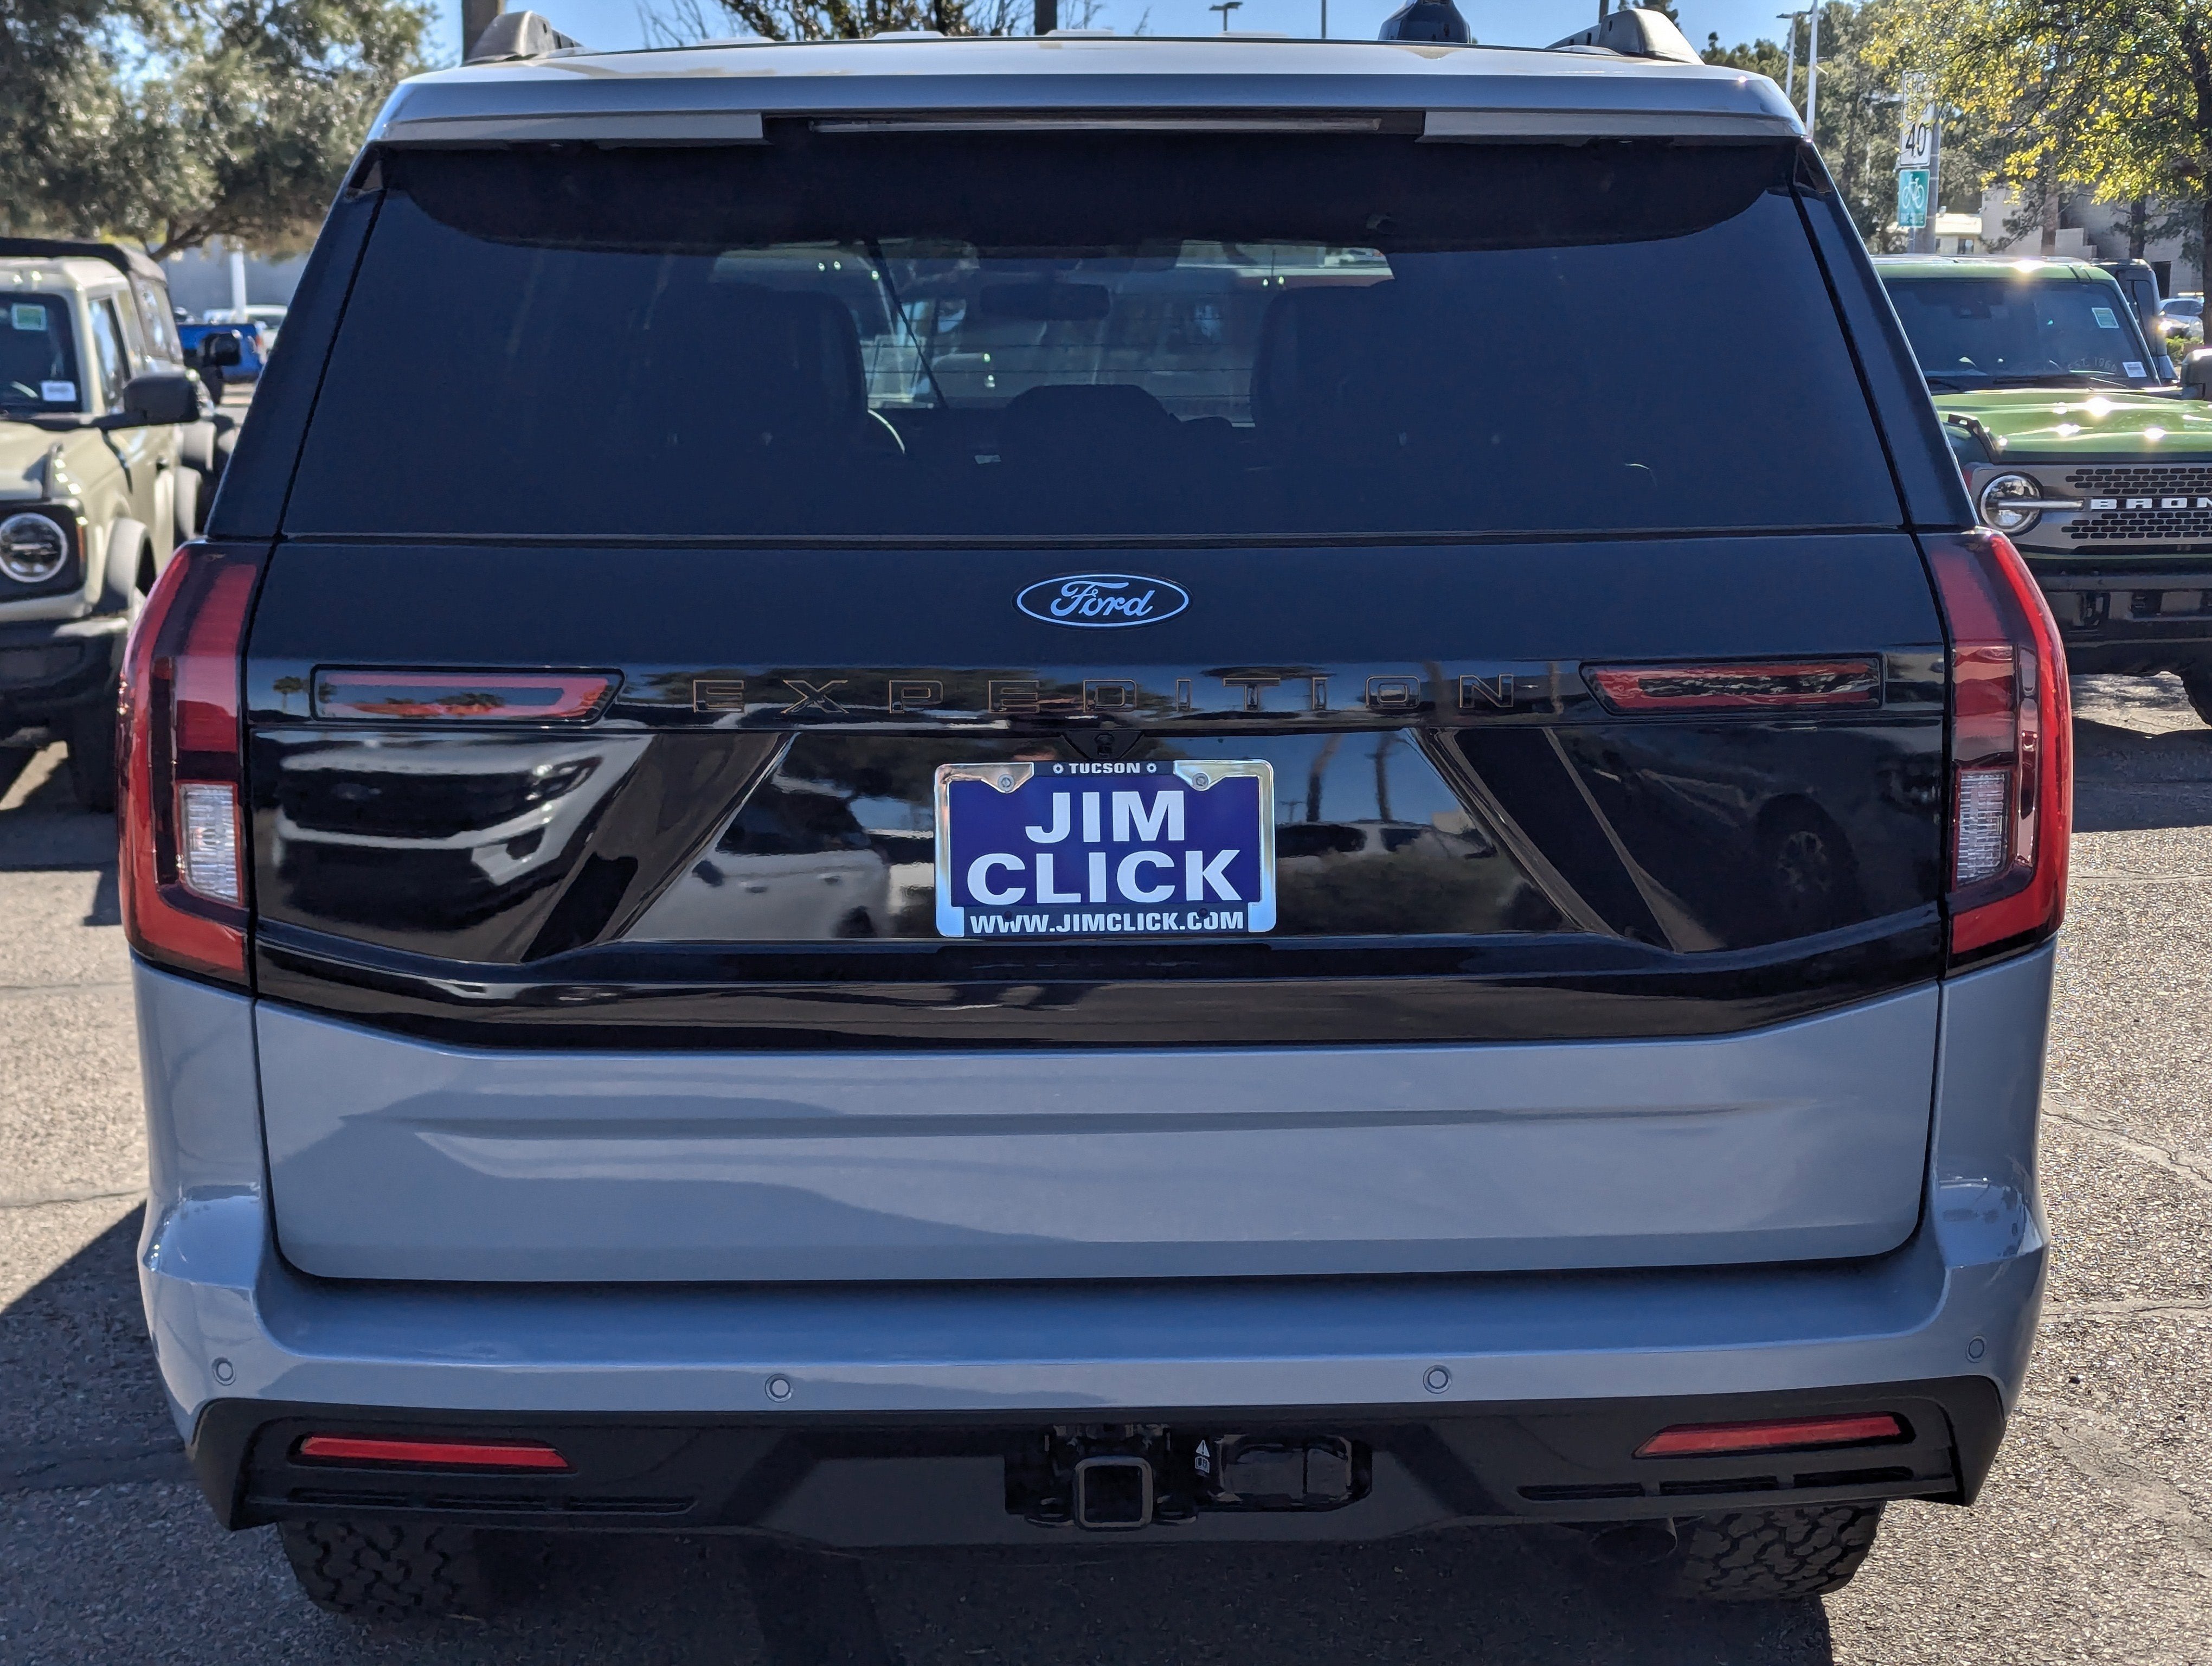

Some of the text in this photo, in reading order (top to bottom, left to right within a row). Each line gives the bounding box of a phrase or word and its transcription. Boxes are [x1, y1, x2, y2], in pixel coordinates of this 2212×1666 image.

[1905, 121, 1927, 157] 40
[1050, 580, 1156, 616] Ford
[692, 673, 1514, 714] EXPEDITION
[1069, 762, 1141, 774] TUCSON
[1025, 790, 1185, 843] JIM
[967, 849, 1243, 905] CLICK
[969, 911, 1244, 934] WWW.JIMCLICK.COM
